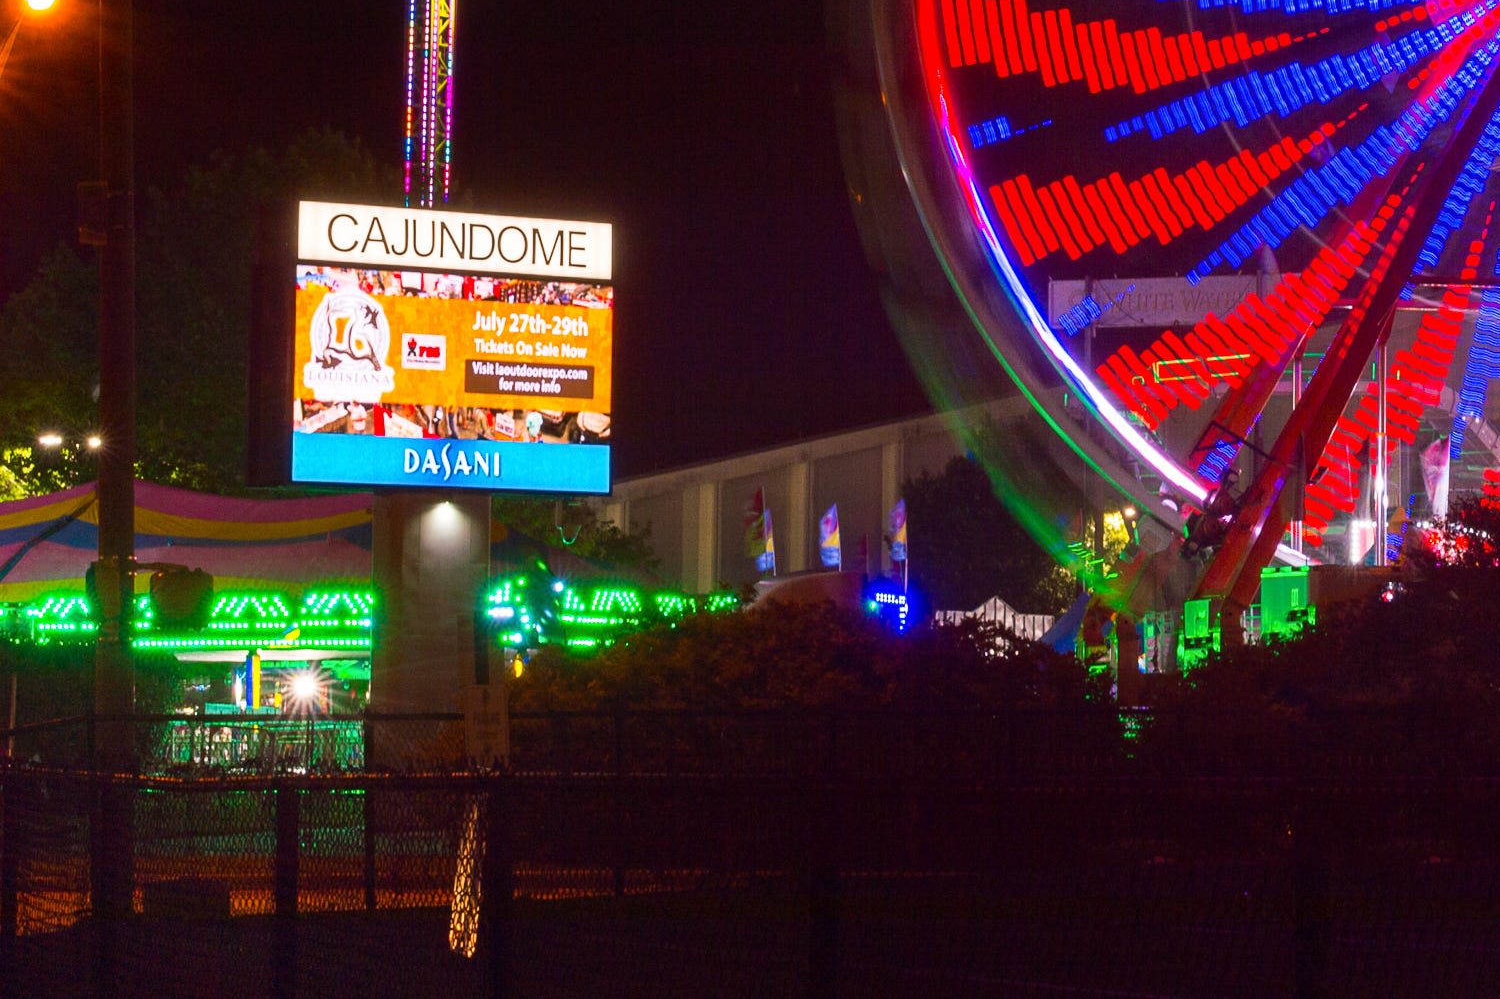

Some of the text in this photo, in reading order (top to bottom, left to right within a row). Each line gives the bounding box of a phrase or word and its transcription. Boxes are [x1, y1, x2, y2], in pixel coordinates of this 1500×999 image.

[327, 213, 588, 269] CAJUNDOME
[472, 310, 589, 337] July 27th-29th
[474, 338, 588, 359] Tickets On Sale Now
[308, 370, 390, 384] LOUISIANA
[472, 361, 588, 380] Visit laoutdoorexpo.com
[498, 377, 561, 394] for more info
[404, 442, 500, 481] DASANI
